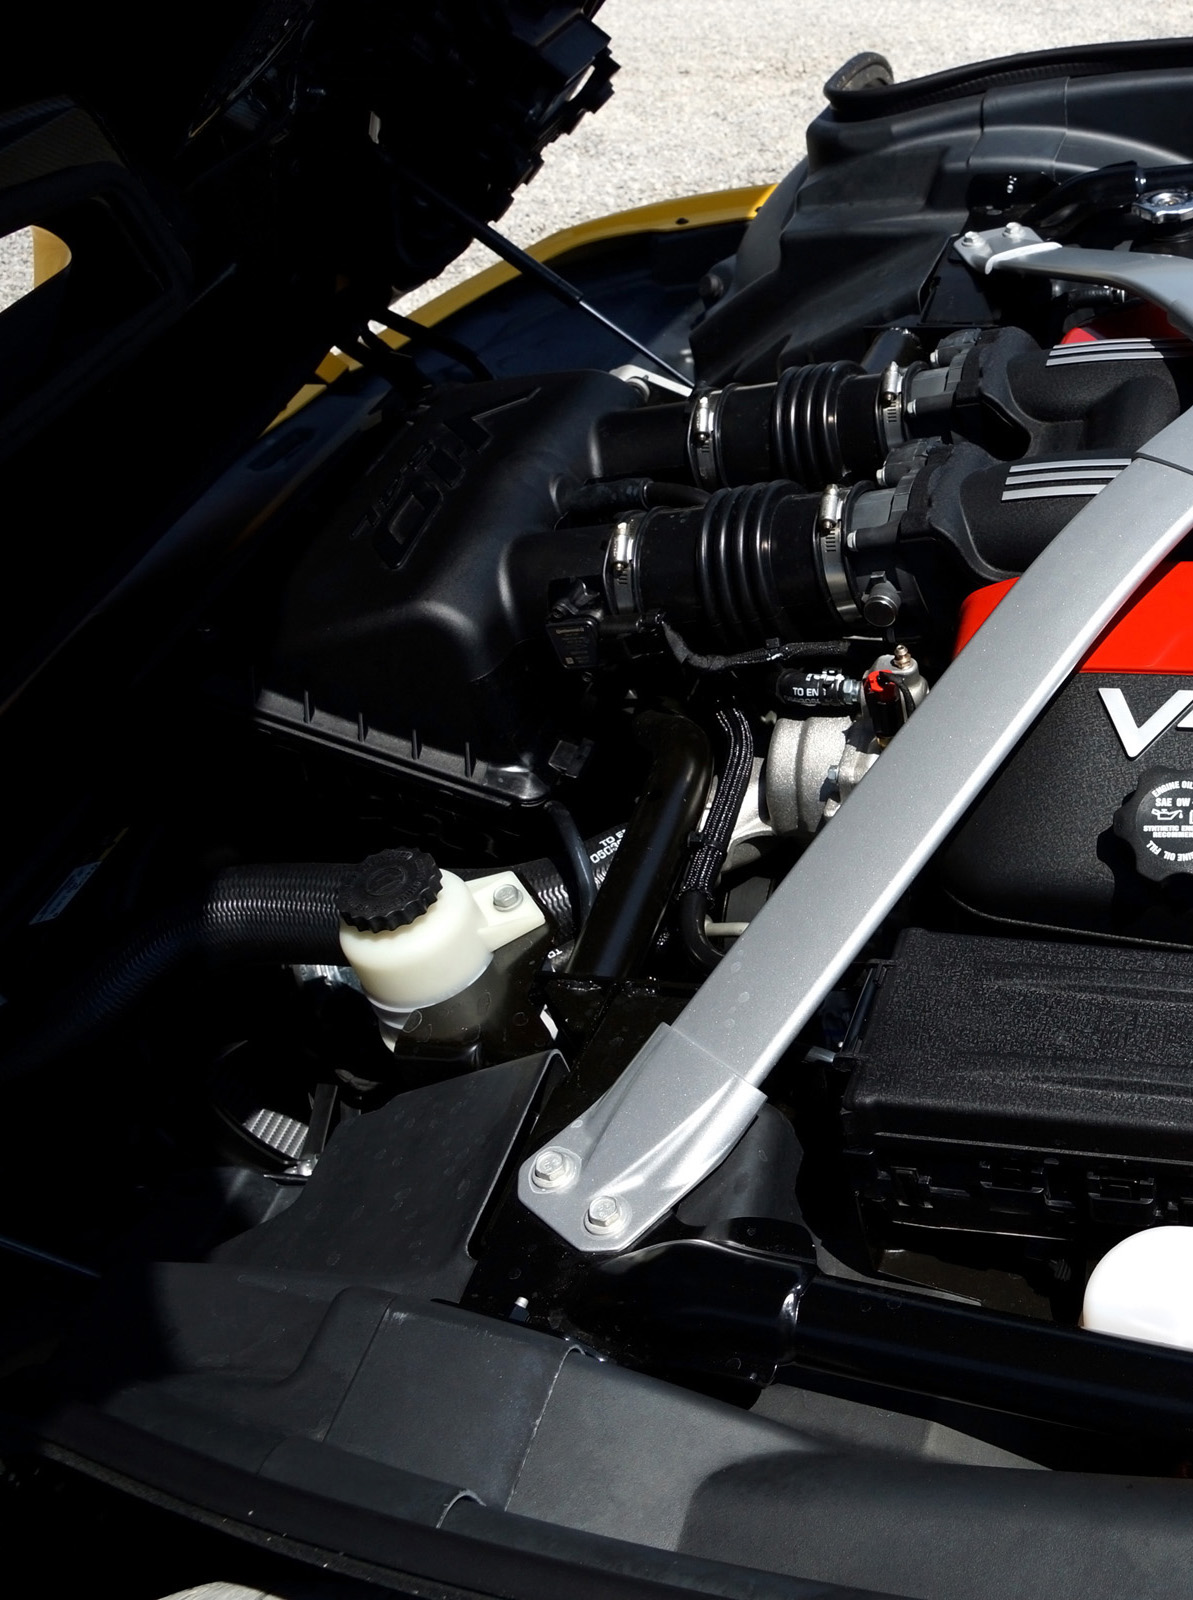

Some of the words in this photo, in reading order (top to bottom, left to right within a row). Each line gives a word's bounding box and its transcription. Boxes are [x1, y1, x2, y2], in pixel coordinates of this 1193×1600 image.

[792, 687, 804, 696] TO
[1152, 780, 1180, 798] ENGINE
[1181, 780, 1193, 790] OIL
[1155, 798, 1172, 807] SAE
[599, 836, 615, 847] TO
[1146, 840, 1162, 855] FILL
[1164, 851, 1176, 861] OIL
